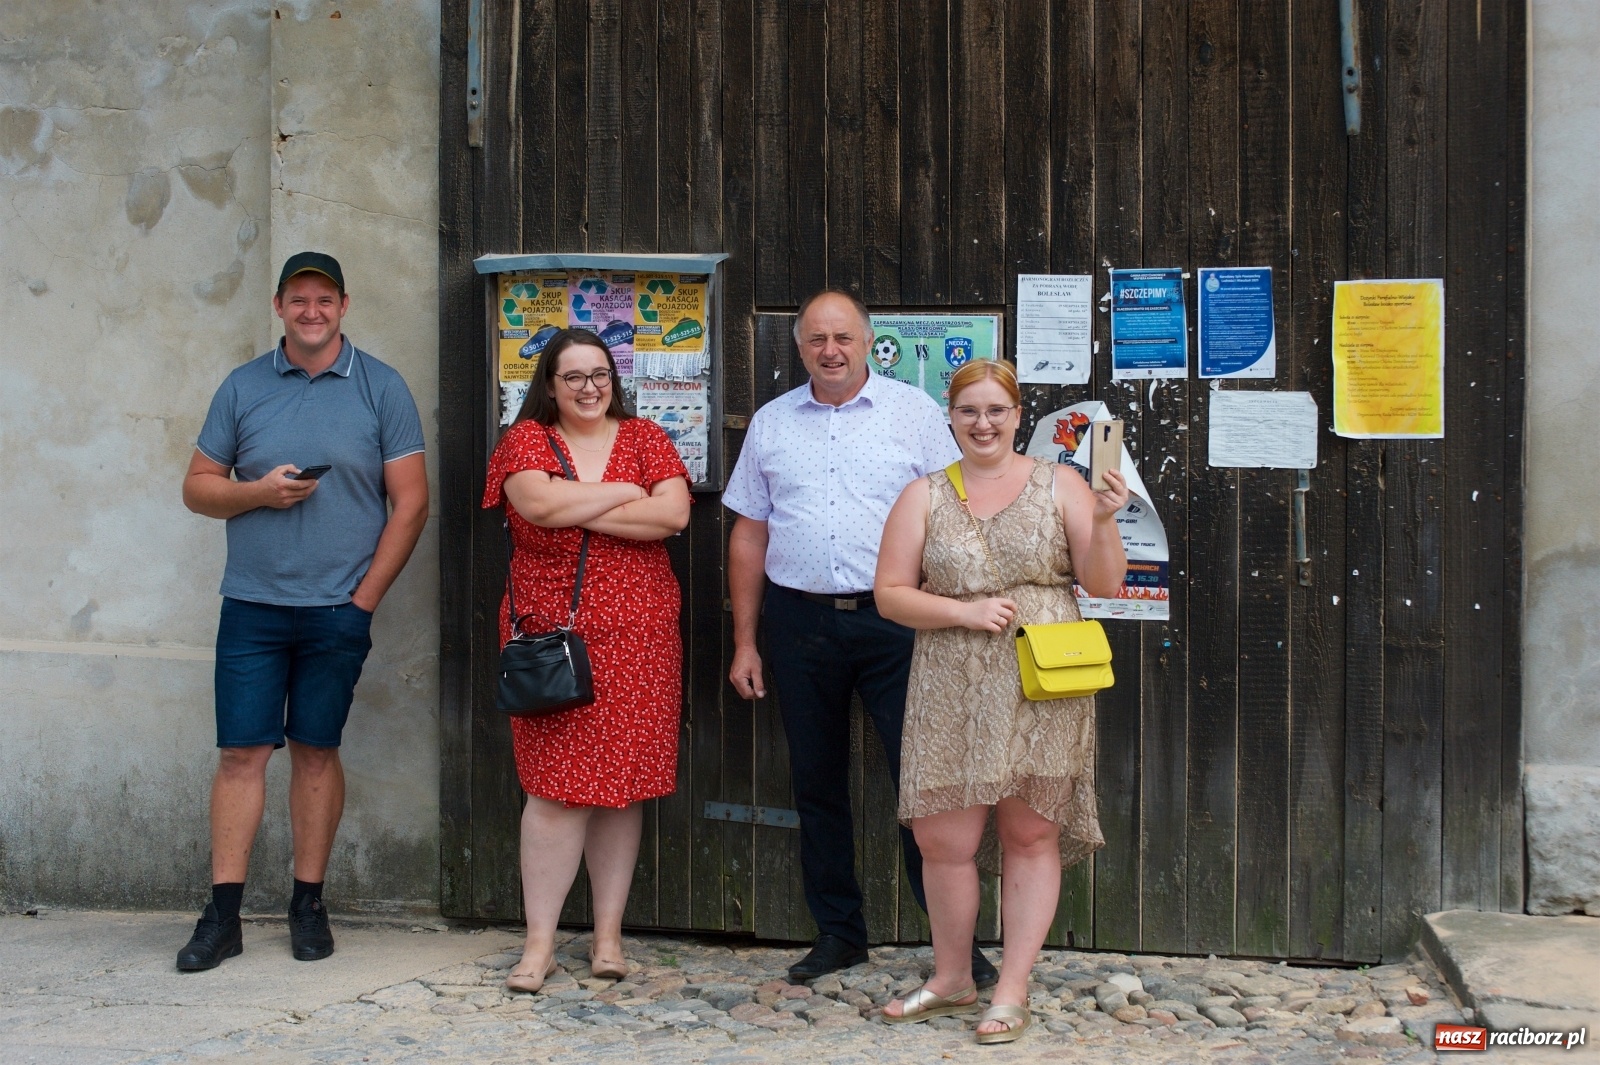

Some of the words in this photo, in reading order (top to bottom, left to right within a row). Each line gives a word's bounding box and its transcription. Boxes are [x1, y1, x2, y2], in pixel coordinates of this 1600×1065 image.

[541, 291, 562, 299] SKUP
[611, 287, 632, 295] SKUP
[678, 288, 699, 296] SKUP
[1119, 288, 1167, 299] #SZCZEPIMY
[530, 299, 563, 307] KASACJA
[590, 301, 633, 309] POJAZDÓW
[657, 302, 699, 310] POJAZDÓW
[522, 305, 563, 314] POJAZDÓW
[670, 327, 701, 338] 501-525-515
[915, 344, 929, 359] VS
[642, 382, 670, 391] AUTO
[672, 382, 702, 391] ZŁOM
[1137, 575, 1159, 583] 15.30
